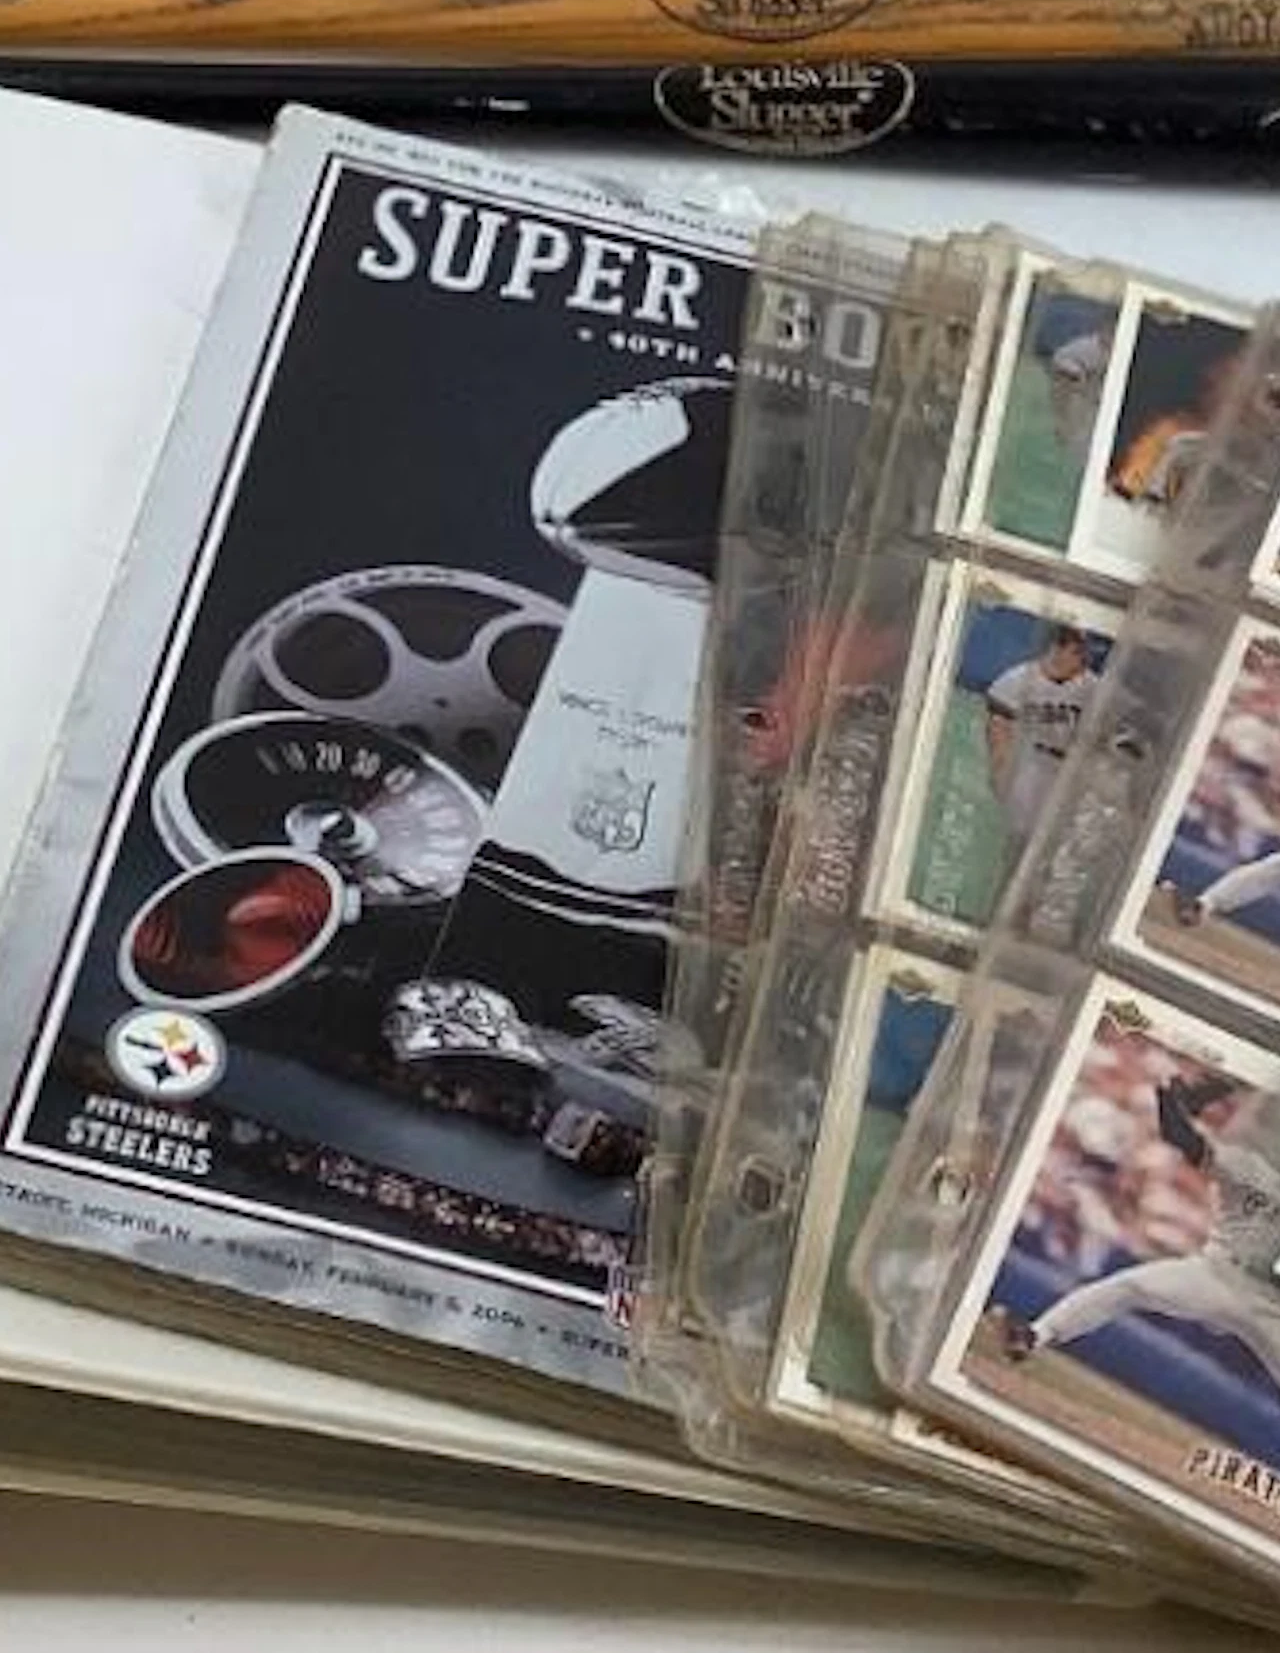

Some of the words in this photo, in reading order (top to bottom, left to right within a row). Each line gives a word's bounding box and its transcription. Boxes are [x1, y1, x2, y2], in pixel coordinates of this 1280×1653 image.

[357, 186, 703, 330] SUPER
[753, 279, 881, 371] BO
[65, 1116, 214, 1178] STEELERS
